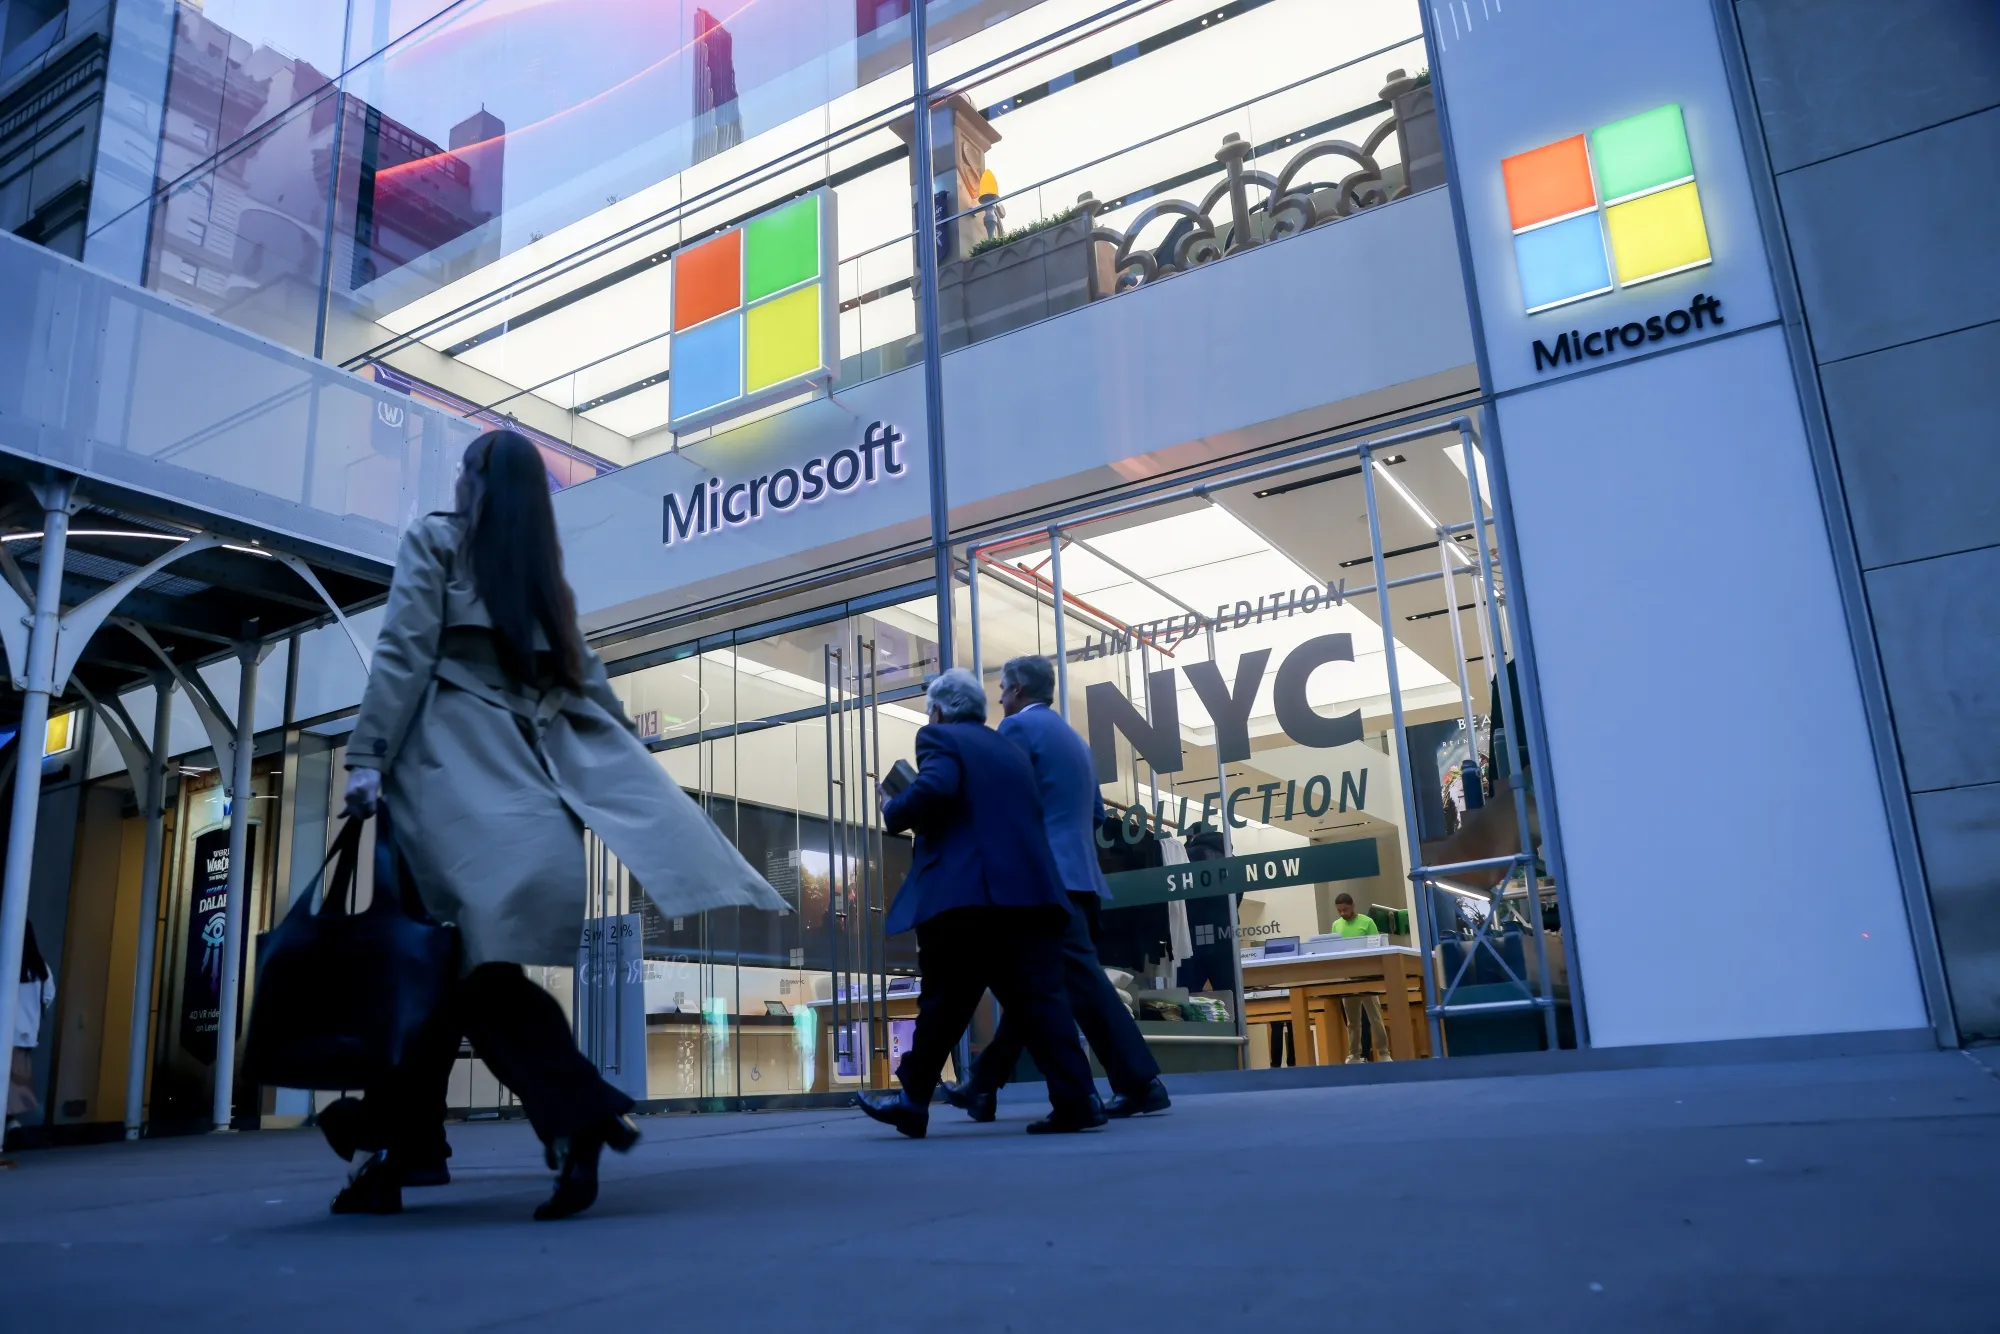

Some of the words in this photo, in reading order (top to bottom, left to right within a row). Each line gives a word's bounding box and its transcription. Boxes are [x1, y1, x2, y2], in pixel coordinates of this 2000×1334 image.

[1533, 294, 1725, 370] Microsoft
[662, 421, 904, 545] Microsoft
[1084, 612, 1200, 661] LIMITED
[1215, 578, 1345, 632] EDITION
[1086, 632, 1364, 785] NYC
[1457, 714, 1491, 730] BEA
[1095, 768, 1368, 849] COLLECTION
[206, 856, 229, 873] WARCR
[1166, 868, 1228, 892] SHOP
[1246, 858, 1300, 882] NOW
[199, 894, 227, 913] DALA
[1218, 920, 1281, 940] Microsoft
[204, 1023, 218, 1032] Leve
